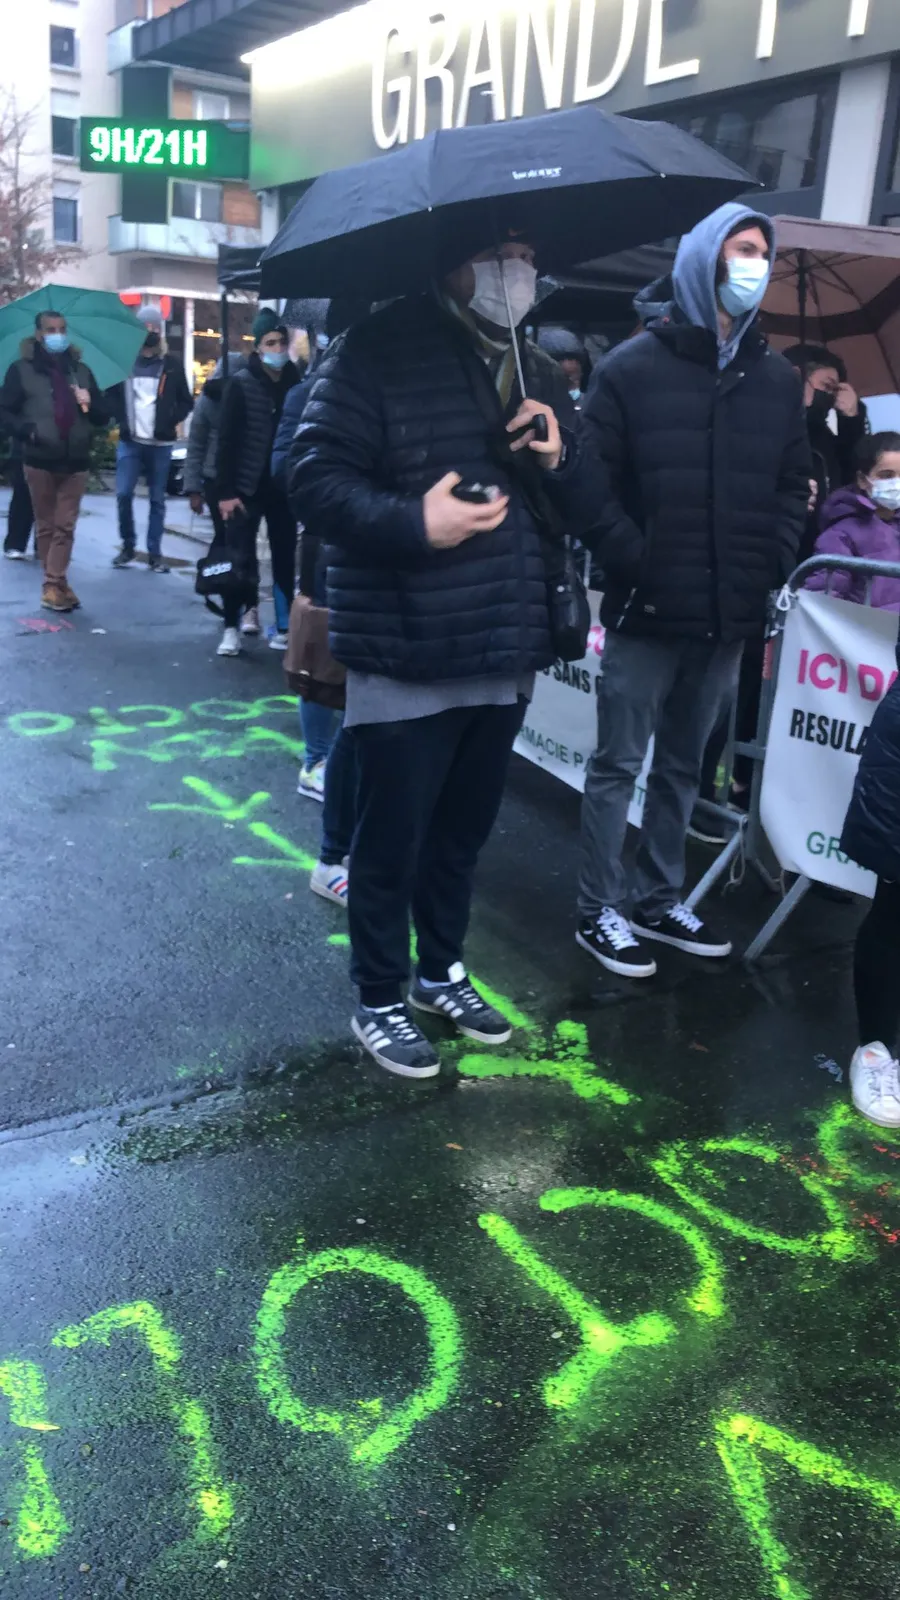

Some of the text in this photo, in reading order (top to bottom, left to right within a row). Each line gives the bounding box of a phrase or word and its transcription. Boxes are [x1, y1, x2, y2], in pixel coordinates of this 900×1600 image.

[90, 126, 207, 166] 9H/21H
[552, 657, 591, 694] SANS
[797, 649, 849, 694] ICI
[806, 831, 850, 865] GR
